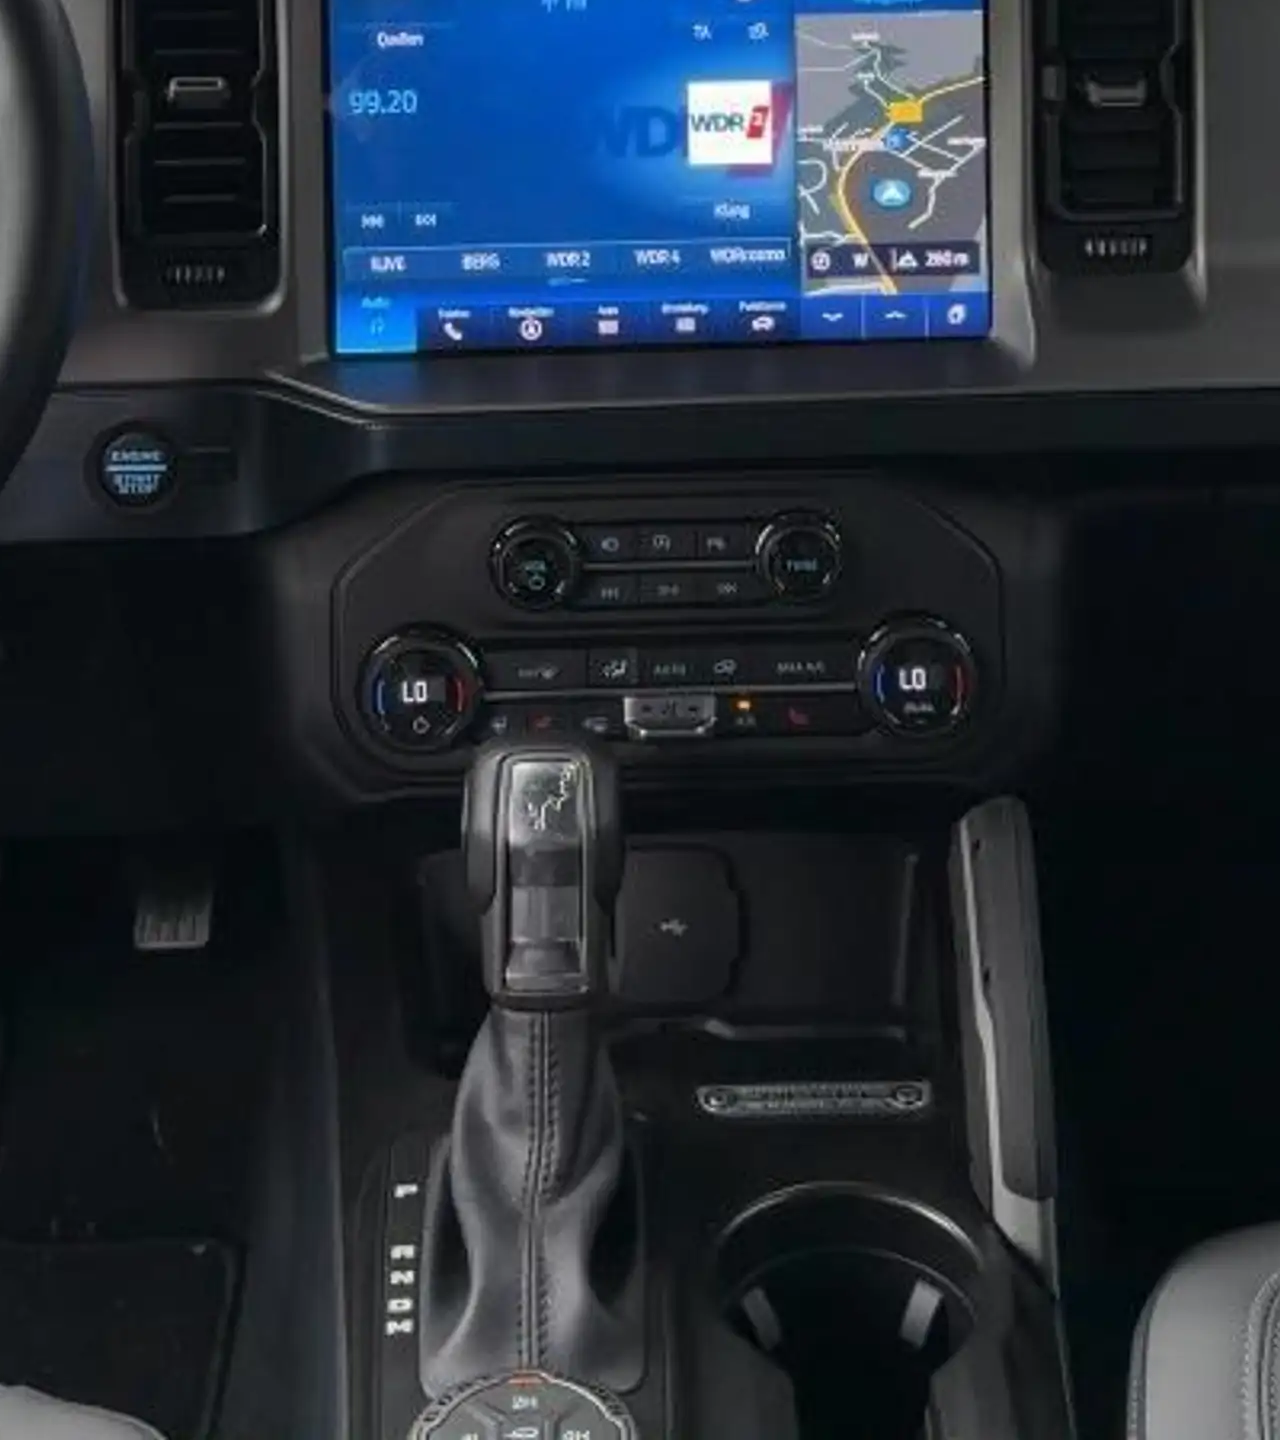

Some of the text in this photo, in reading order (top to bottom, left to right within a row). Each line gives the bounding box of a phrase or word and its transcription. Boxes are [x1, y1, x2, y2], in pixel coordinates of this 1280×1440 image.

[349, 90, 418, 115] 99.20
[690, 112, 744, 133] WDR
[111, 450, 163, 462] ENGINE
[898, 667, 926, 691] LO
[400, 680, 428, 703] LO
